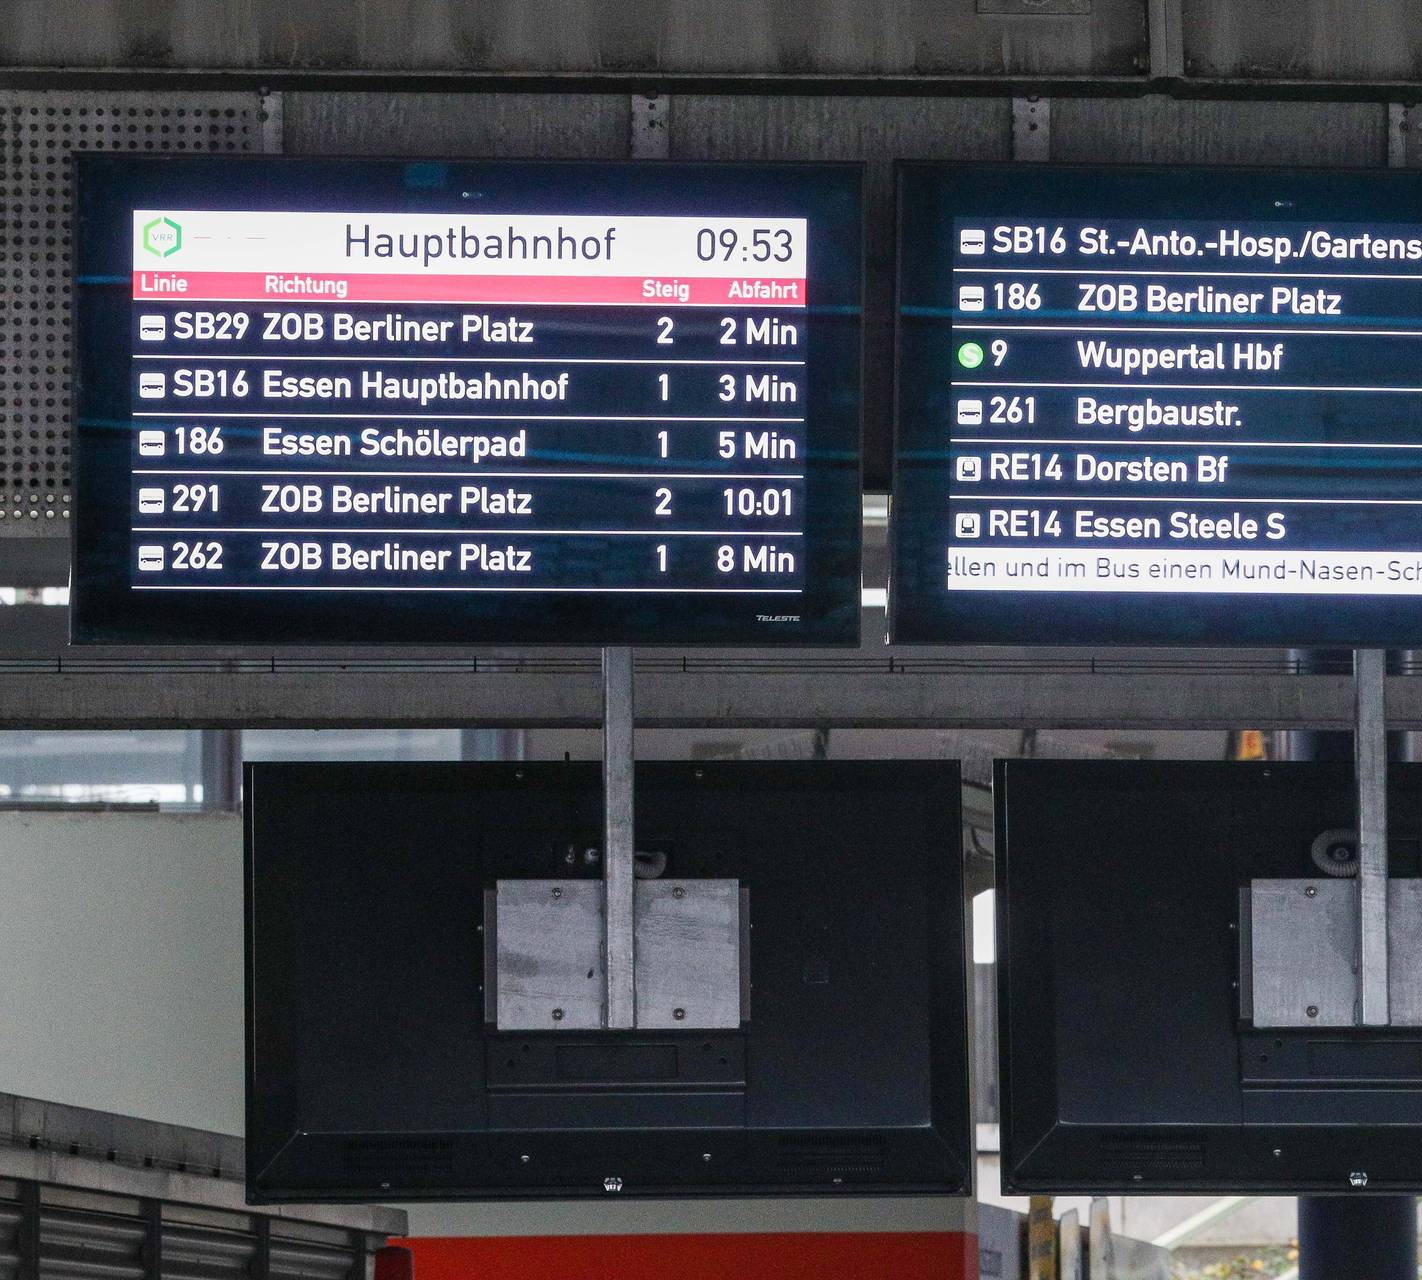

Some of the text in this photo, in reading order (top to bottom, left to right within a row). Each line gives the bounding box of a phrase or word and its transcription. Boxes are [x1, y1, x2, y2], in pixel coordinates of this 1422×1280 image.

[152, 233, 173, 241] VRR
[346, 224, 616, 267] Hauptbahnhof
[697, 229, 792, 262] 09:53
[993, 226, 1066, 253] SB16
[142, 274, 797, 302] Linie Richtung Steig Abfahrt
[995, 283, 1041, 310] 186
[1078, 284, 1137, 311] ZOB
[1147, 285, 1264, 313] Berliner
[1272, 287, 1341, 314] Platz
[174, 312, 797, 344] SB29 ZOB Berliner Platz 2 2 Min
[992, 340, 1007, 366] 9
[1077, 341, 1224, 375] Wuppertal
[1234, 343, 1283, 370] Hbf
[173, 369, 796, 405] SB16 Essen Hauptbahnhof 1 3 Min
[990, 396, 1034, 423] 261
[1078, 398, 1241, 432] Bergbaustr.
[175, 427, 795, 463] 186 Essen Schölerpad 1 5 Min
[991, 453, 1062, 480] RE14
[1077, 454, 1187, 481] Dorsten
[1198, 456, 1228, 482] Bf
[173, 485, 791, 515] 291 ZOB Berliner Platz 2 10:01
[990, 510, 1061, 537] RE14
[1076, 511, 1160, 538] Essen
[1169, 512, 1258, 539] Steele
[1266, 513, 1285, 539] S
[172, 542, 794, 572] 262 ZOB Berliner Platz 1 8 Min
[1007, 557, 1048, 577] und
[1059, 557, 1085, 577] im
[1097, 558, 1139, 577] Bus
[1149, 559, 1211, 578] einen
[755, 614, 800, 622] TELESTE
